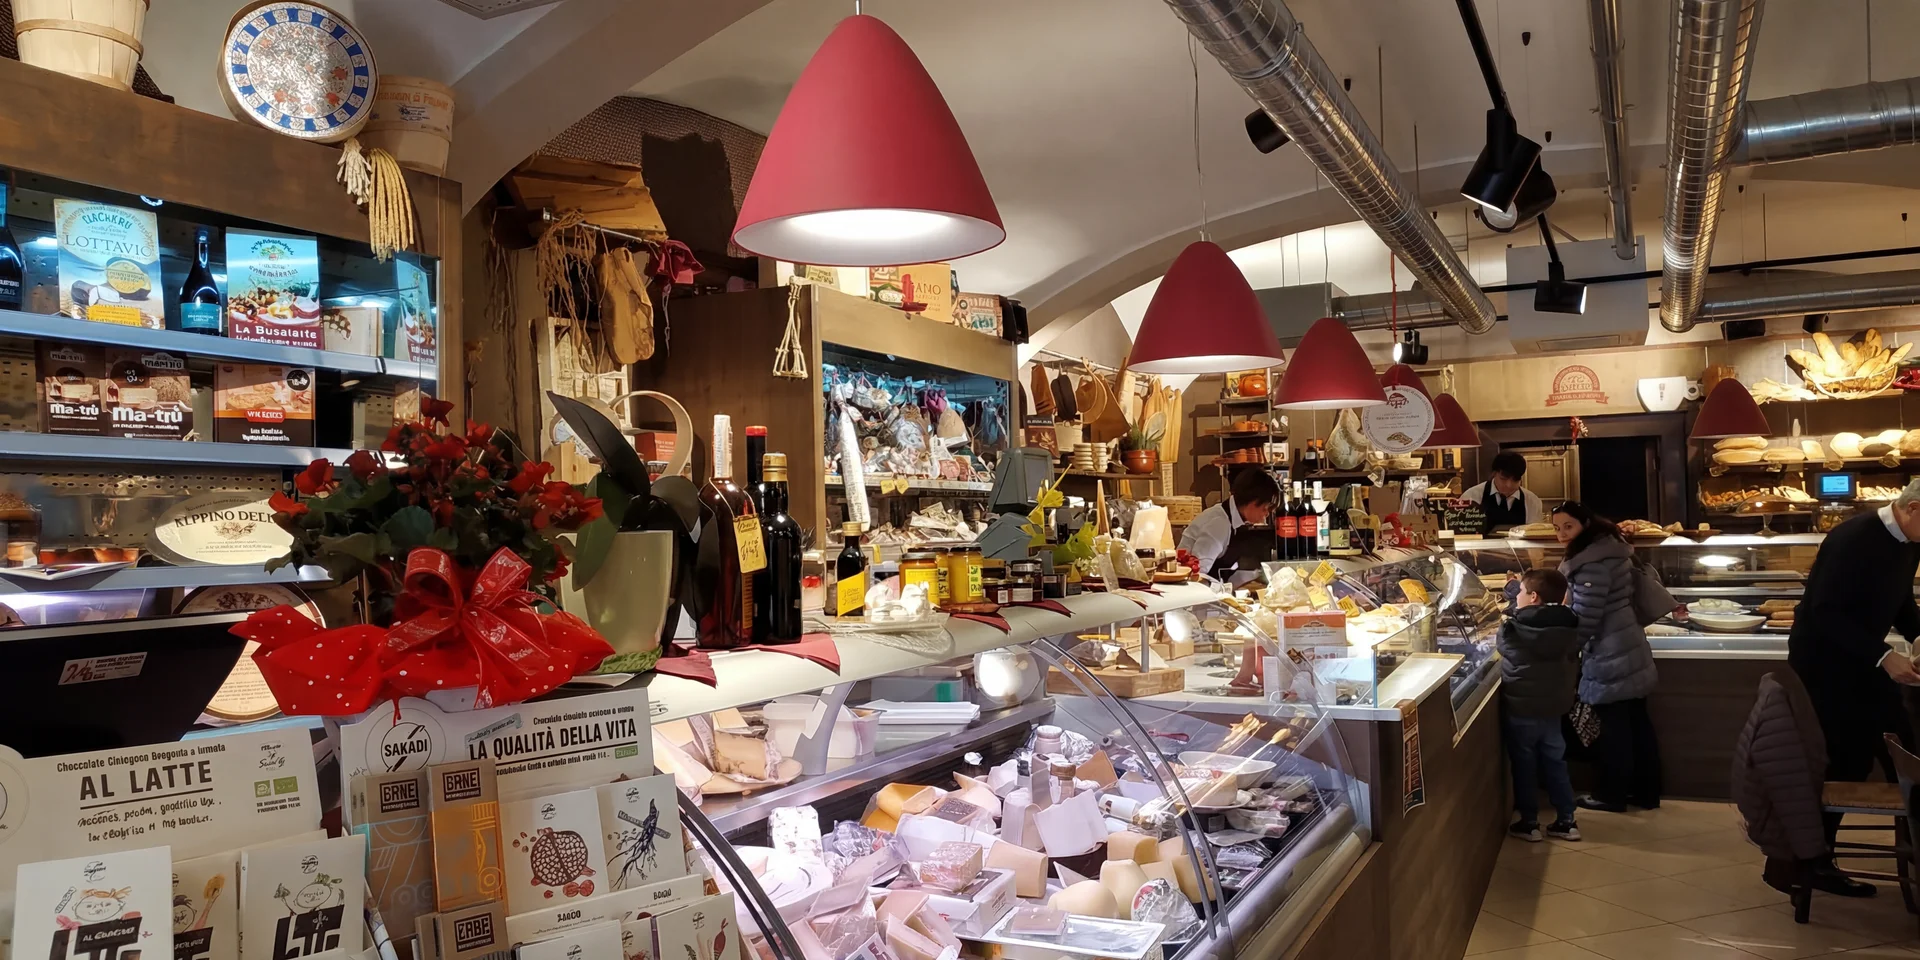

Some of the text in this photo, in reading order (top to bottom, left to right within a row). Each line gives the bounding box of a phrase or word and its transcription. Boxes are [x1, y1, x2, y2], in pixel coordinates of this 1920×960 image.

[384, 739, 428, 757] SAKADI
[468, 740, 488, 760] LA
[493, 726, 555, 761] QUALITÀ
[560, 723, 602, 748] DELLA
[606, 718, 637, 740] VITA
[79, 759, 213, 800] AL LATTE
